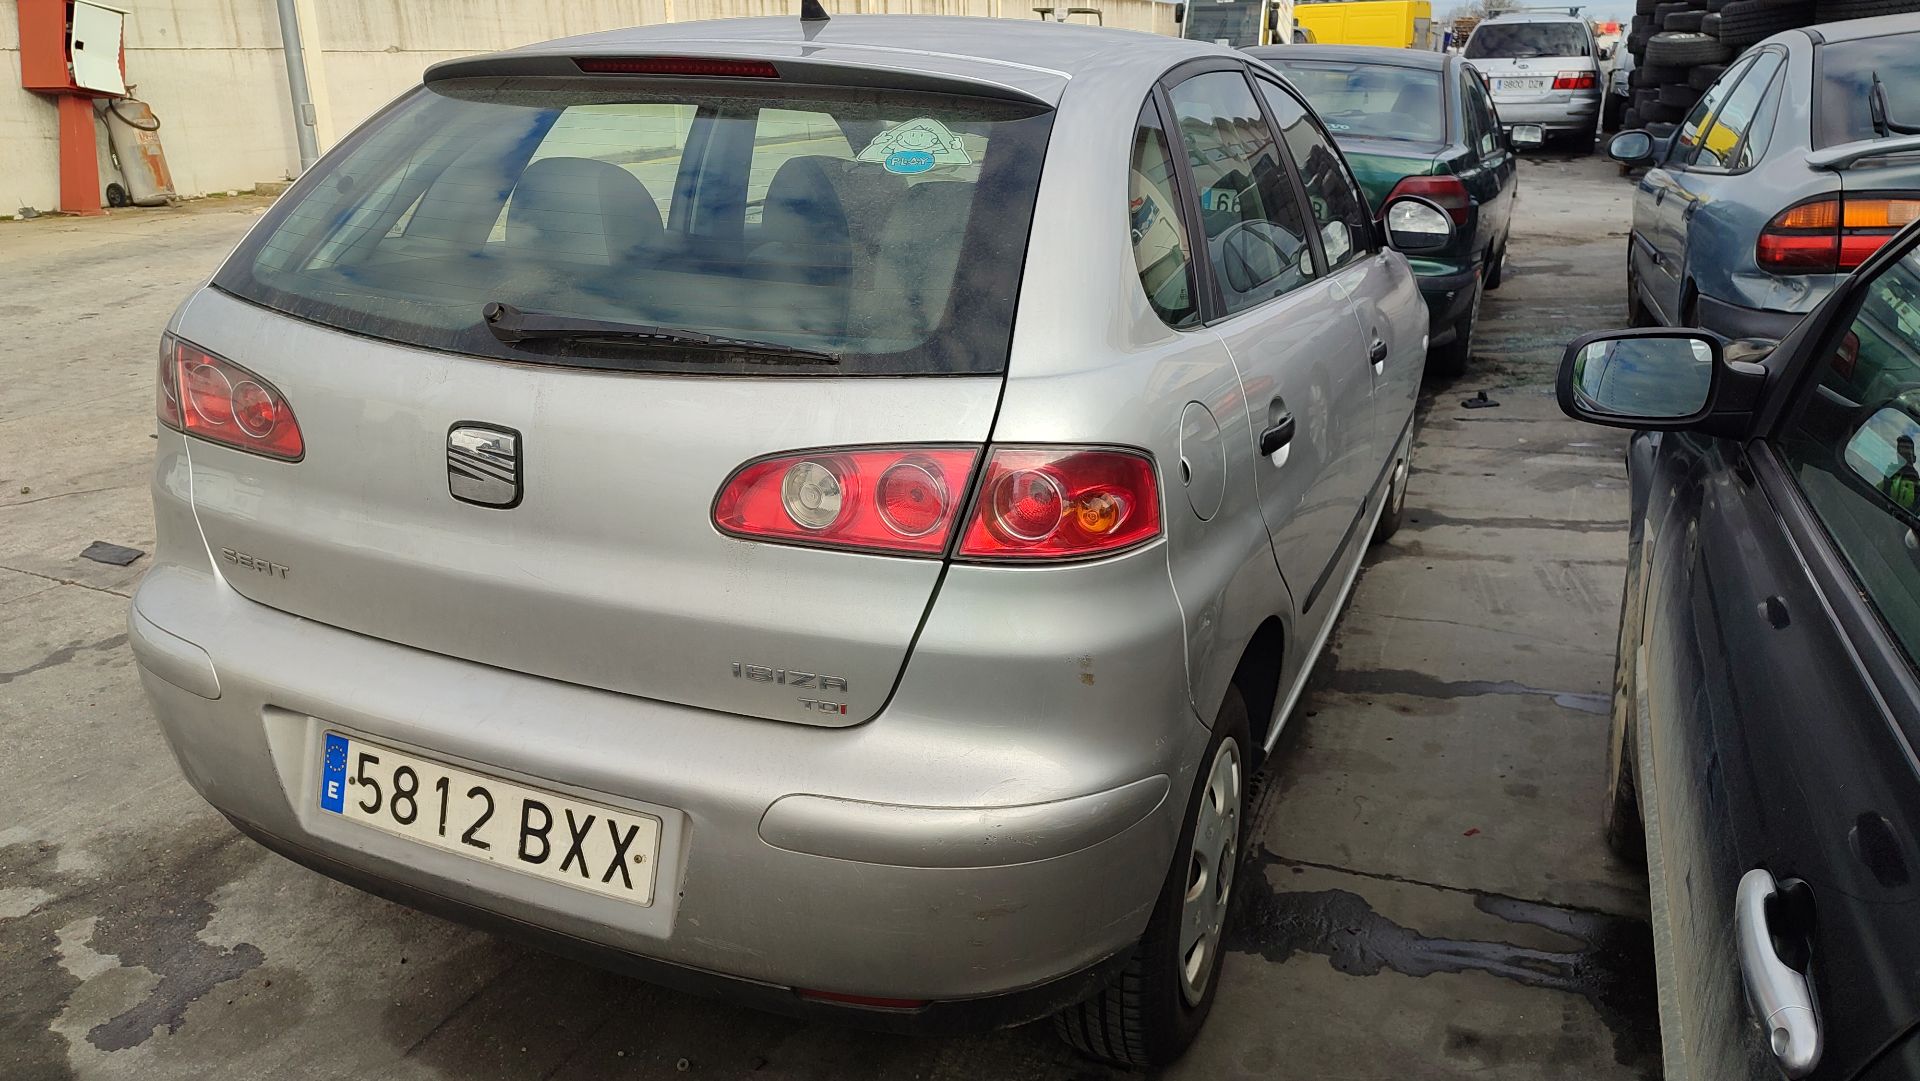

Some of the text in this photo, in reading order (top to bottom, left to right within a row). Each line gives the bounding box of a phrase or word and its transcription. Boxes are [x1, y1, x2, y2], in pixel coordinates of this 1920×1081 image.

[891, 157, 929, 166] PLAY
[221, 547, 290, 580] SEAT
[731, 661, 848, 693] IBIZA
[797, 697, 848, 715] TDI
[327, 780, 340, 801] E
[356, 752, 641, 891] 5812 BXX
